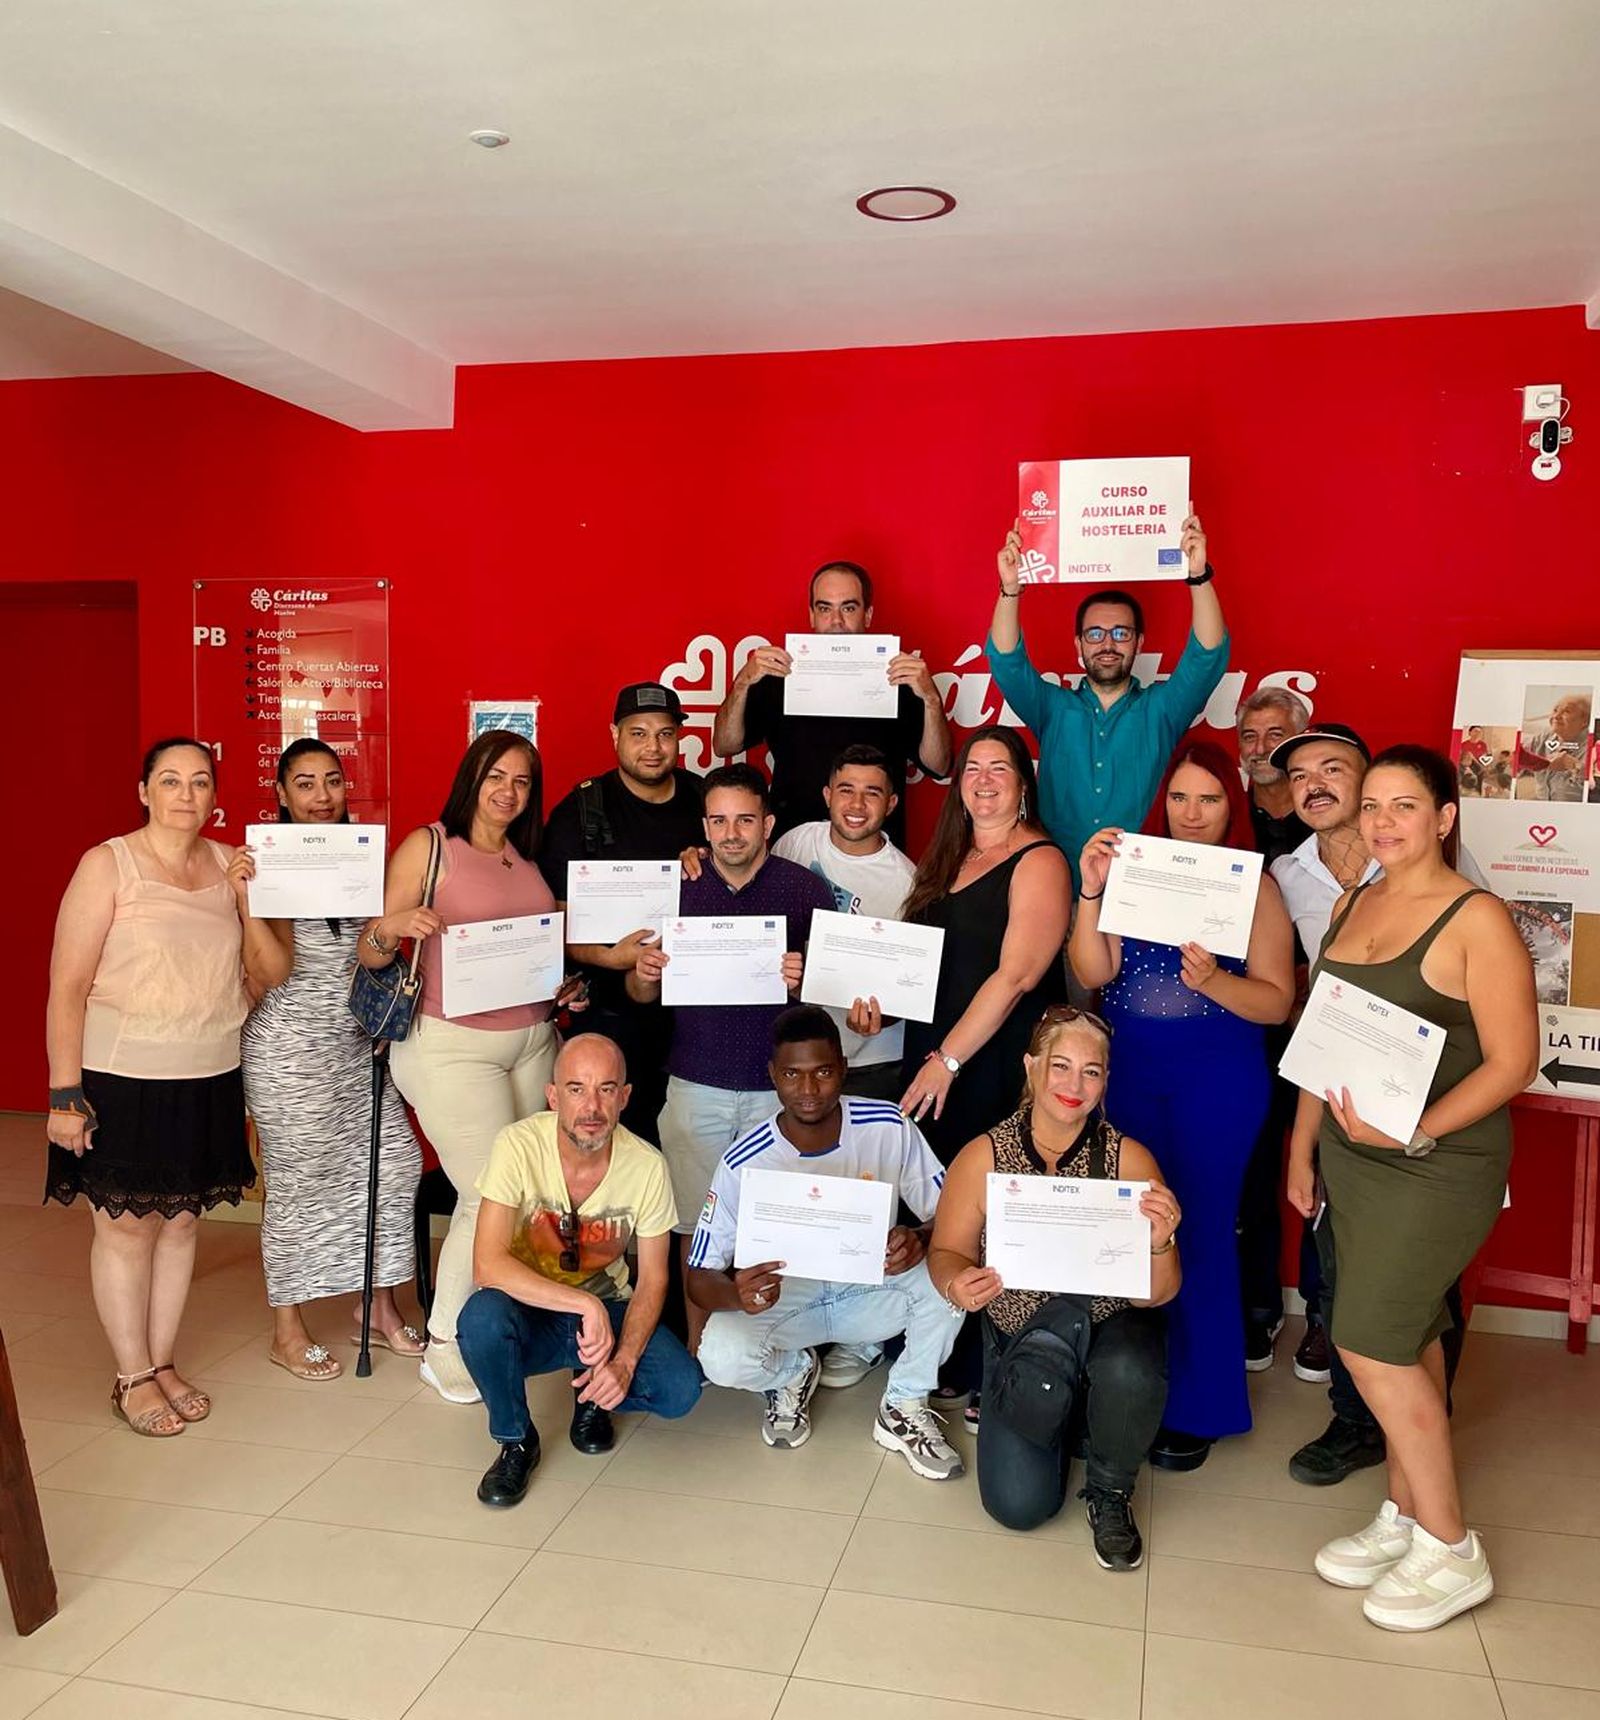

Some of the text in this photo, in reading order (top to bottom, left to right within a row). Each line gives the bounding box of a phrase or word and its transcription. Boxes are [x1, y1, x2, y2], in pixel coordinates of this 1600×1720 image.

[1101, 486, 1148, 498] CURSO
[1081, 504, 1167, 518] AUXILIAR DE
[1081, 523, 1167, 537] HOSTELERIA
[1068, 564, 1112, 574] INDITEX
[273, 589, 328, 601] Cáritas
[193, 626, 227, 647] PB
[257, 629, 297, 641] Acogida
[257, 645, 291, 655] Familia
[257, 661, 379, 673] Centro Puertas Abiertas
[257, 677, 283, 688] Salón
[287, 679, 299, 688] de
[258, 757, 271, 767] de
[1548, 1032, 1600, 1052] LA TI
[1052, 1184, 1081, 1195] INDITEX
